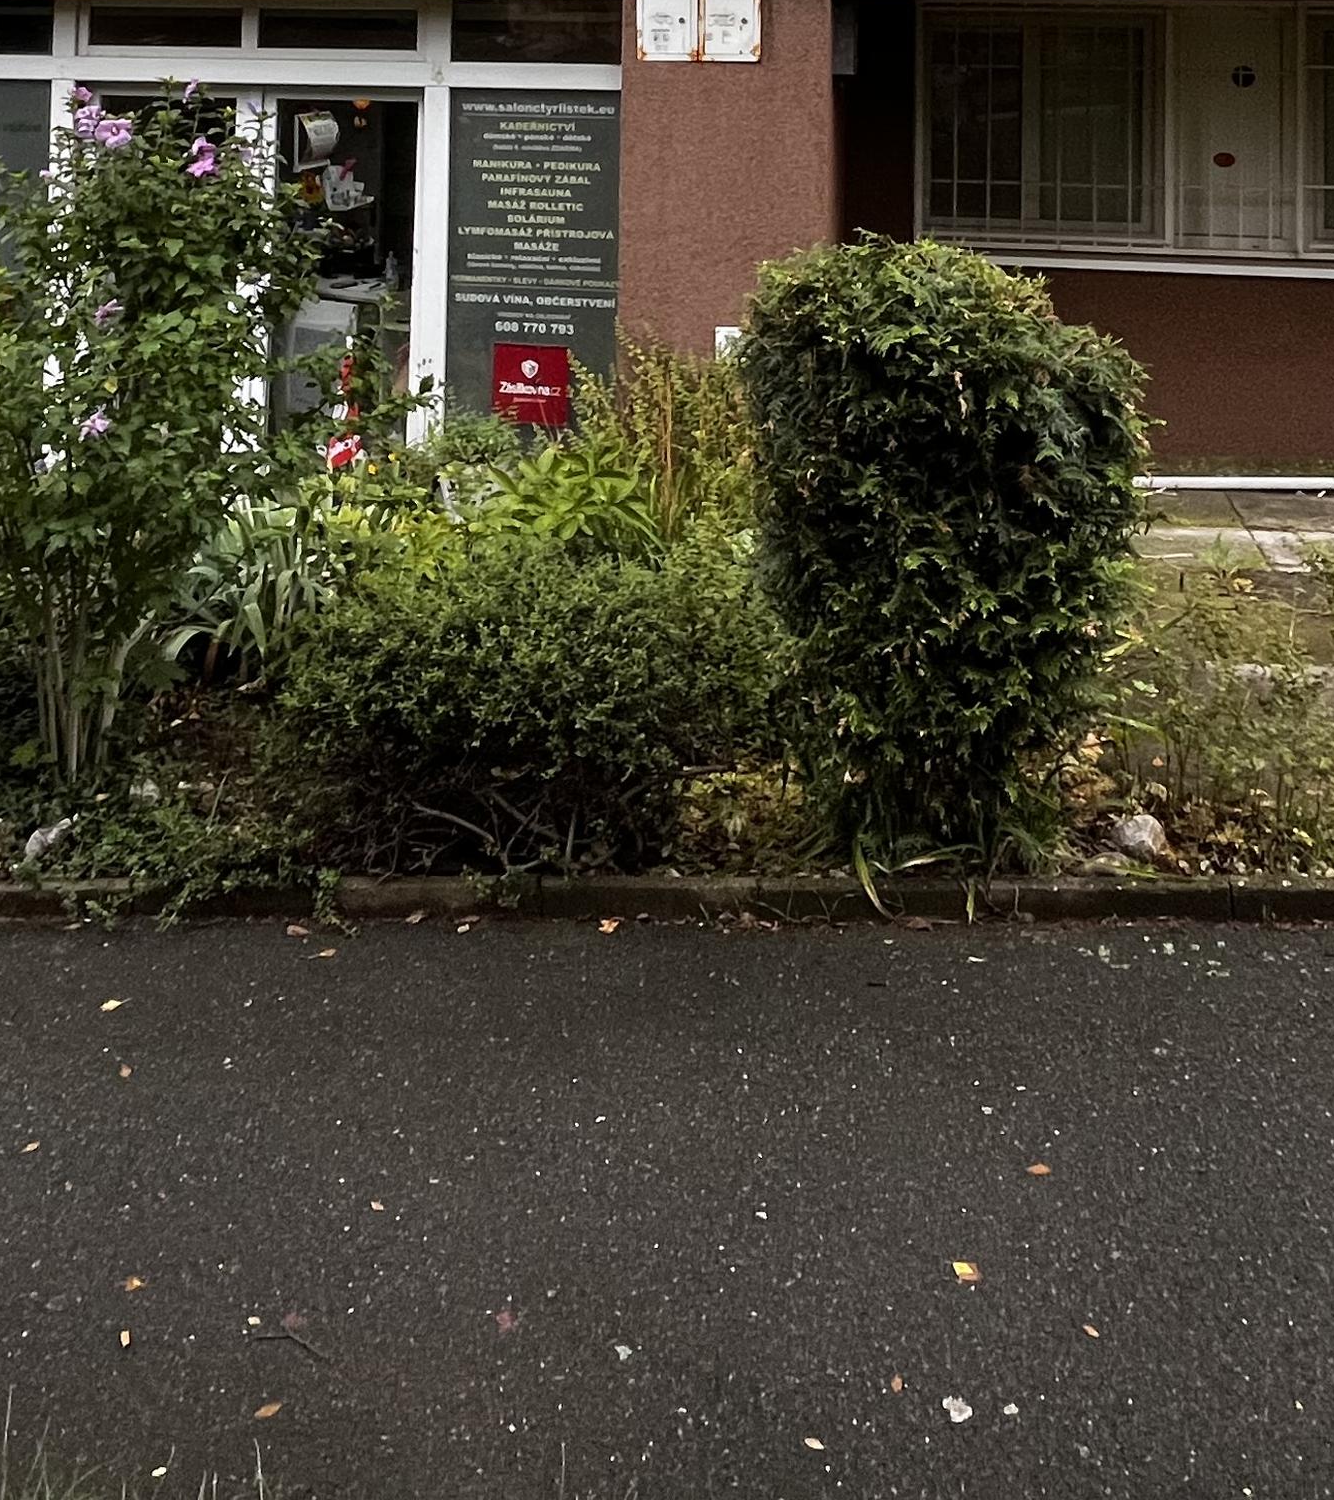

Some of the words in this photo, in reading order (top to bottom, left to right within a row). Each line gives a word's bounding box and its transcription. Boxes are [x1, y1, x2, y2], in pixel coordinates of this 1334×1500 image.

[462, 102, 615, 116] www.salonctyrlistek.eu
[499, 121, 576, 132] KADEŘNICTVÍ
[500, 186, 572, 198] INFRASAUNA
[487, 199, 526, 210] MASÁŽ
[507, 213, 565, 225] SOLÁRIUM
[458, 226, 533, 237] LYMFOMASÁŽ
[514, 241, 559, 251] MASÁŽE
[536, 296, 616, 309] OBČERSTVENÍ
[494, 321, 519, 333] 608
[523, 322, 547, 334] 770
